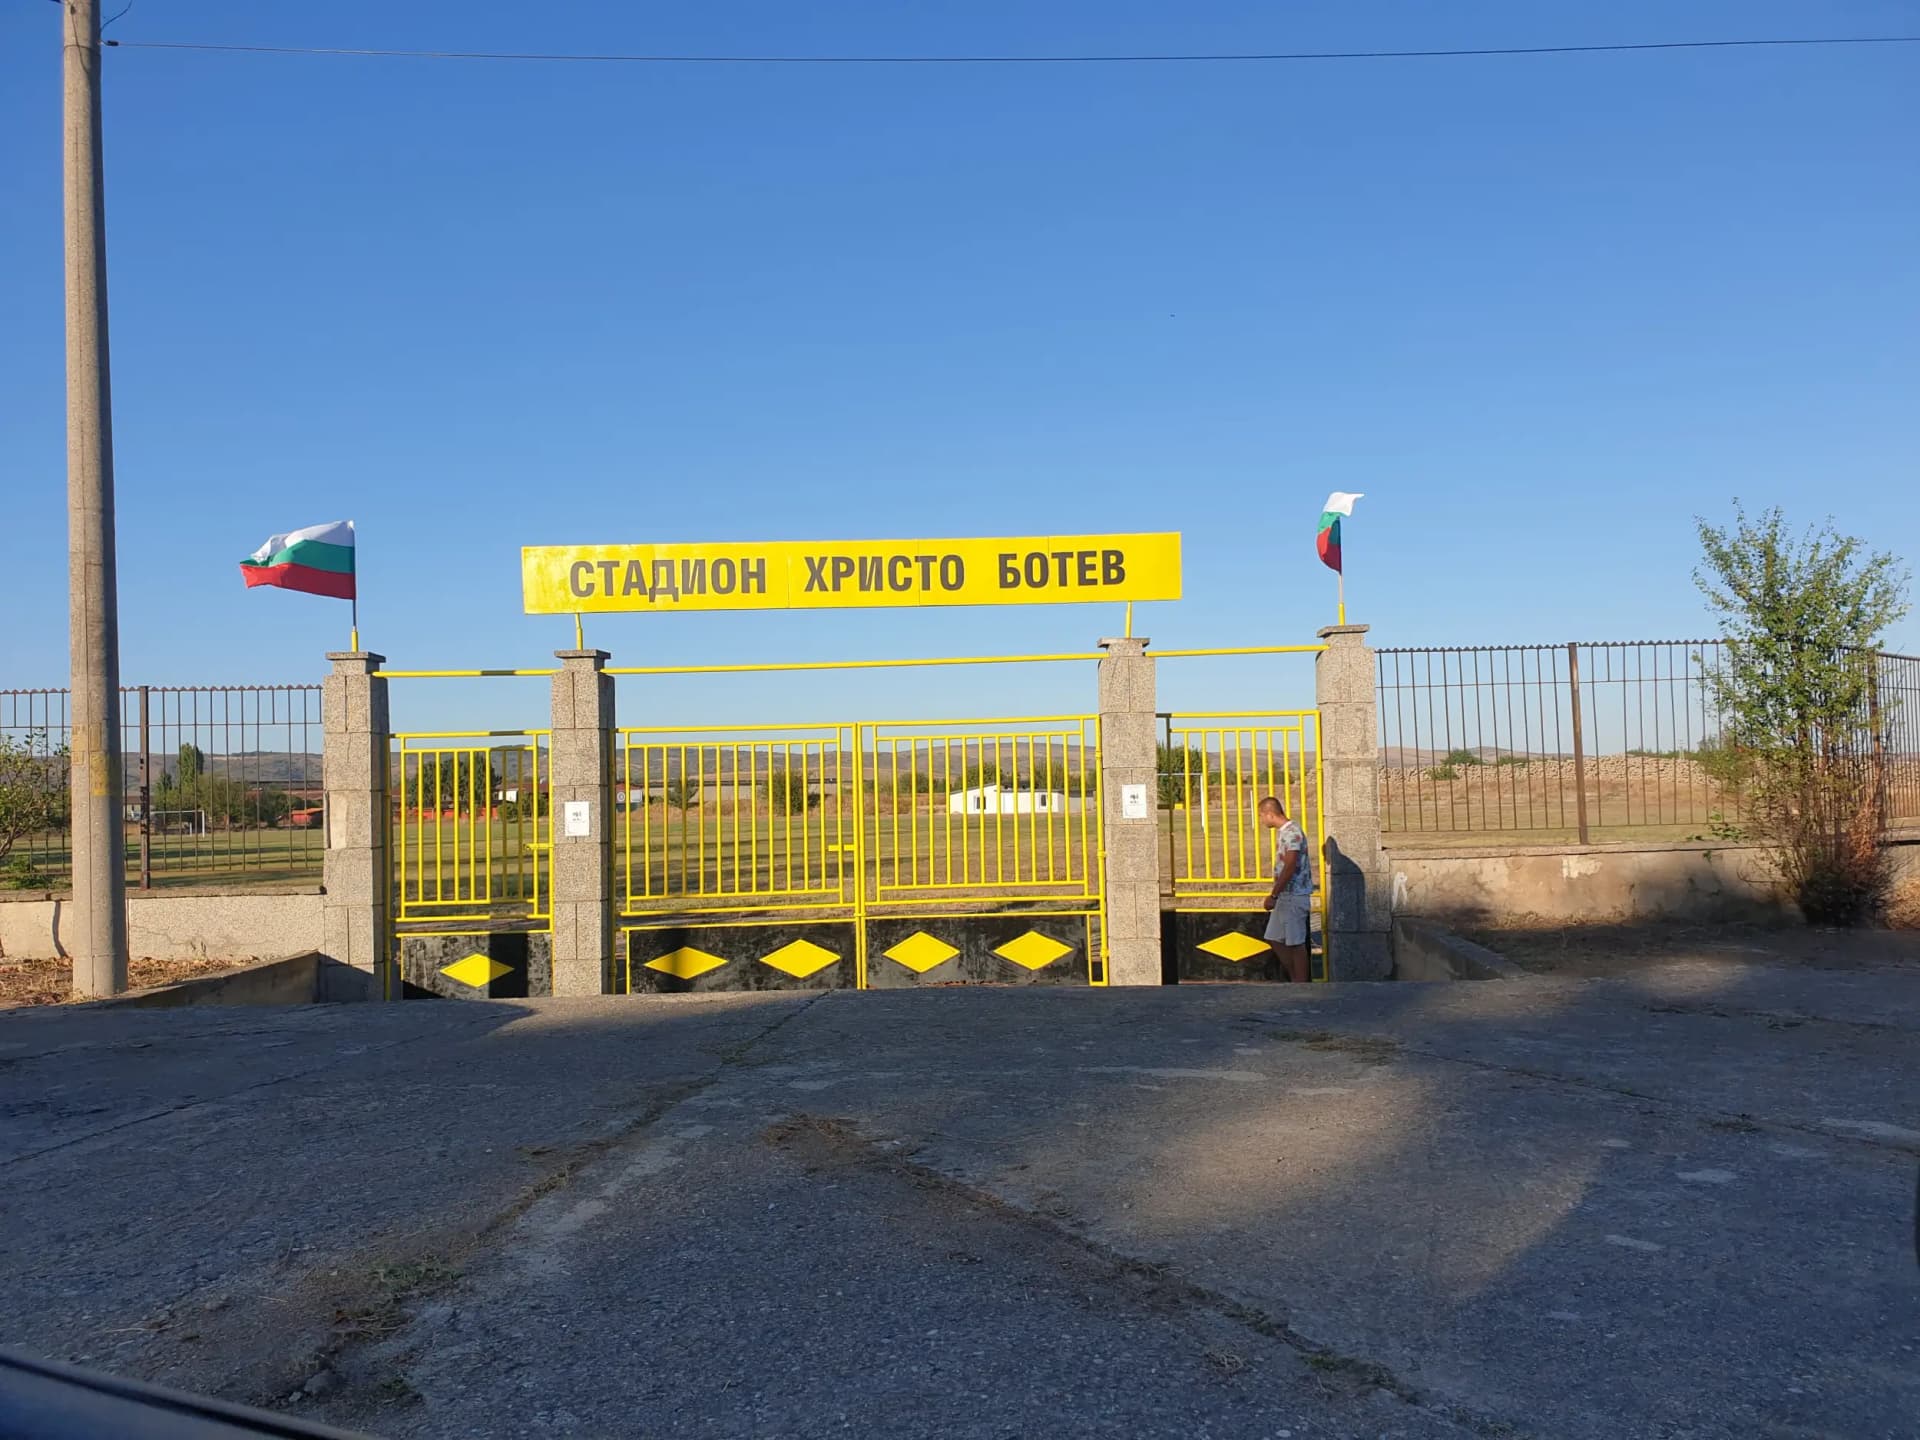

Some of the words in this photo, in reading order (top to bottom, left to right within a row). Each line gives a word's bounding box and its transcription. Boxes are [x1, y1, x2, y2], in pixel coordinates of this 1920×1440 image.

[570, 558, 767, 603] СТАДИОН
[804, 554, 966, 593] ХРИСТО
[998, 549, 1126, 589] БОТЕВ
